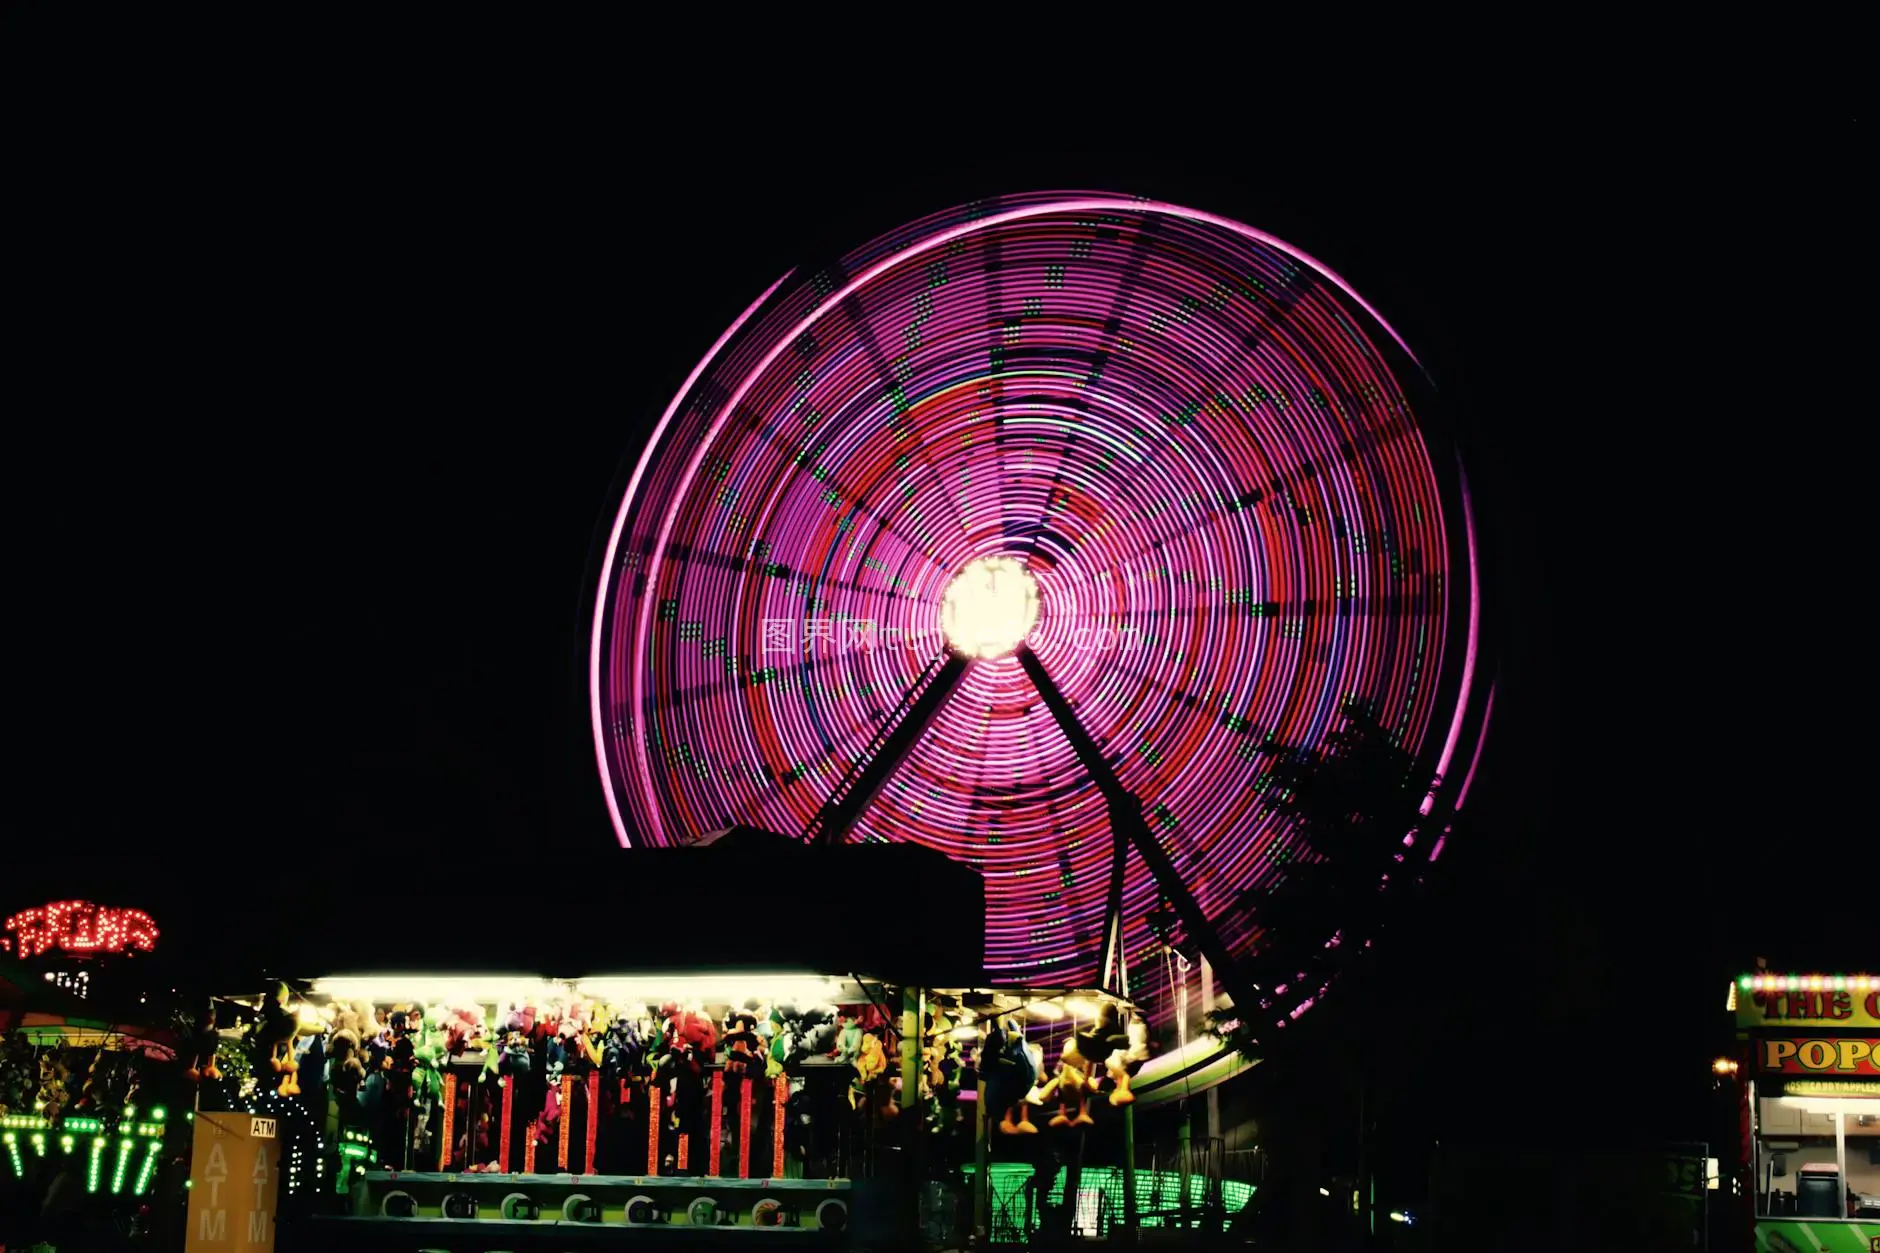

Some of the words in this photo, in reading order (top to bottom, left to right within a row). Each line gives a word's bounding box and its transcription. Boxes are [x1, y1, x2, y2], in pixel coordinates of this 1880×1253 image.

[1753, 990, 1853, 1020] THE
[1765, 1040, 1880, 1070] POP
[253, 1120, 275, 1136] ATM
[200, 1143, 228, 1241] ATM
[248, 1146, 268, 1243] ATM
